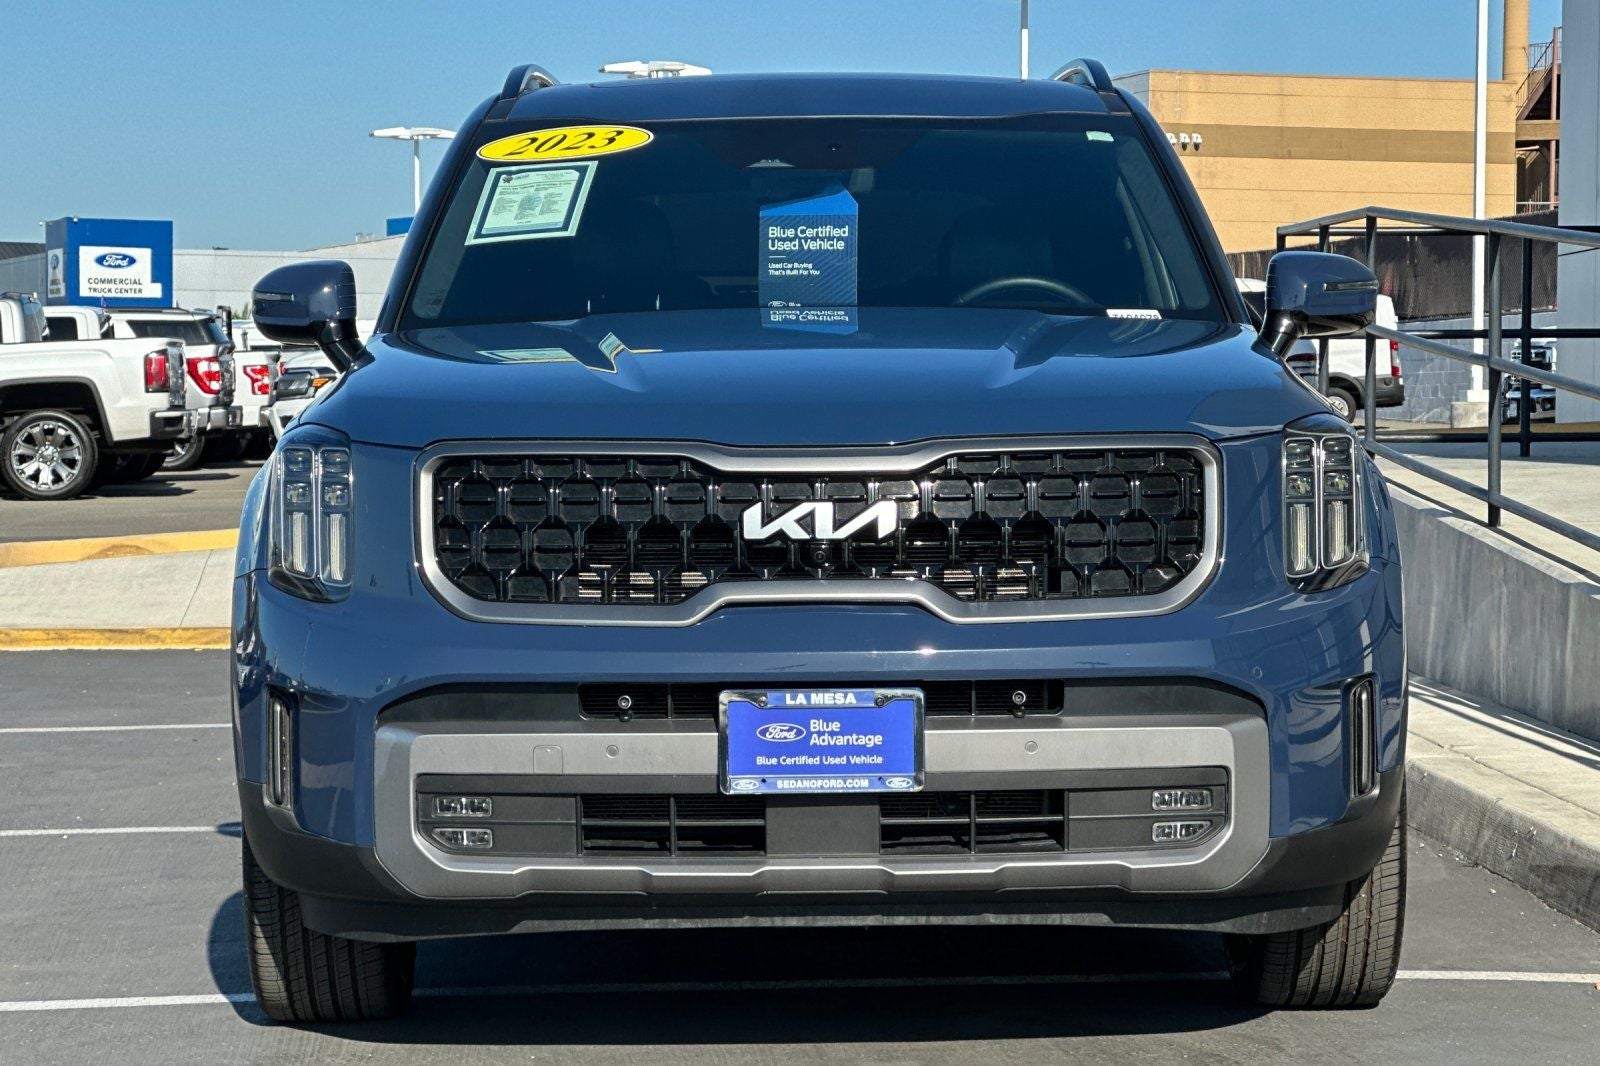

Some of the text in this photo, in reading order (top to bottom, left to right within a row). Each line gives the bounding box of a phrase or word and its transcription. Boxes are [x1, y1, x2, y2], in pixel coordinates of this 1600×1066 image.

[502, 130, 625, 157] 2023
[768, 225, 849, 238] Blue Certified
[768, 238, 845, 251] Used Vehicle
[794, 262, 813, 270] Buying
[87, 277, 143, 286] COMMERCIAL
[114, 287, 143, 295] CENTER
[743, 500, 898, 540] KIA
[785, 693, 857, 705] LA MESA
[809, 719, 841, 732] Blue
[809, 733, 883, 748] Advantage
[755, 754, 883, 766] Blue Certified Used Vehicle
[776, 779, 869, 788] SEDANOFORD.COM
